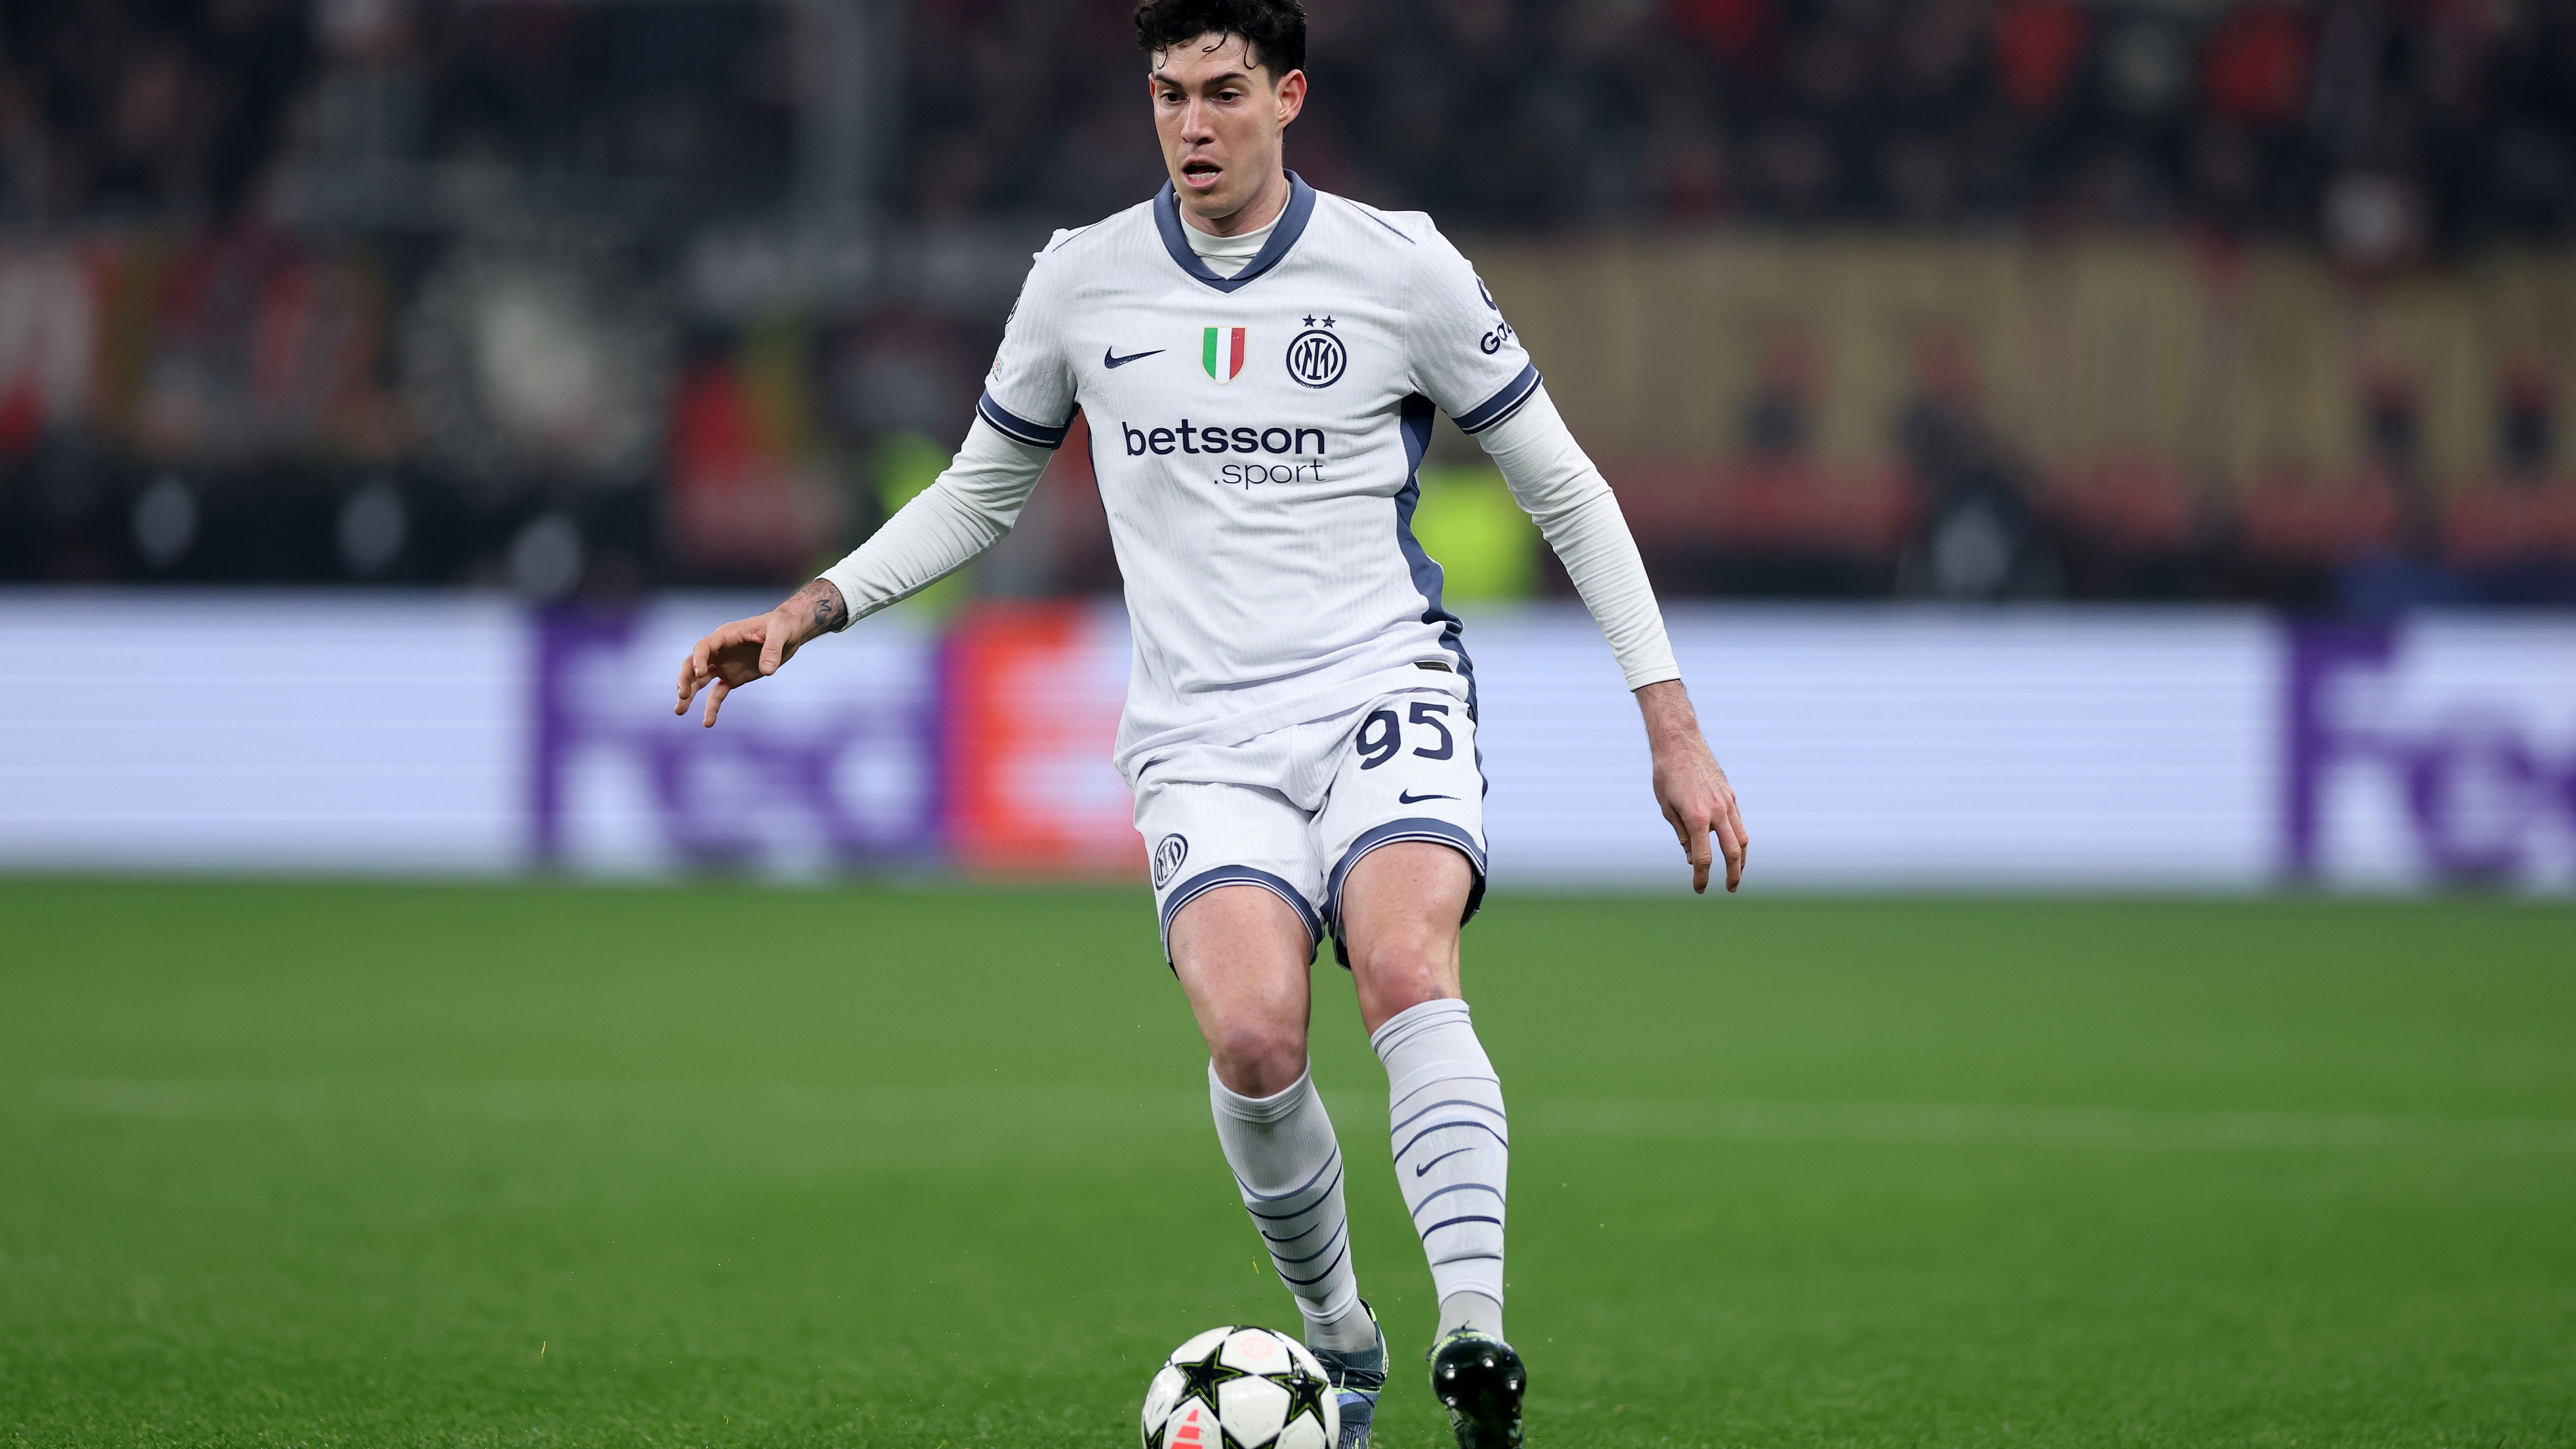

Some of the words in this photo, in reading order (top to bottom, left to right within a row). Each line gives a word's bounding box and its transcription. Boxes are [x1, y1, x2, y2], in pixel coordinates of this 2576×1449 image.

[1122, 419, 1325, 456] betsson
[1214, 459, 1326, 490] .sport
[1356, 701, 1453, 770] 95
